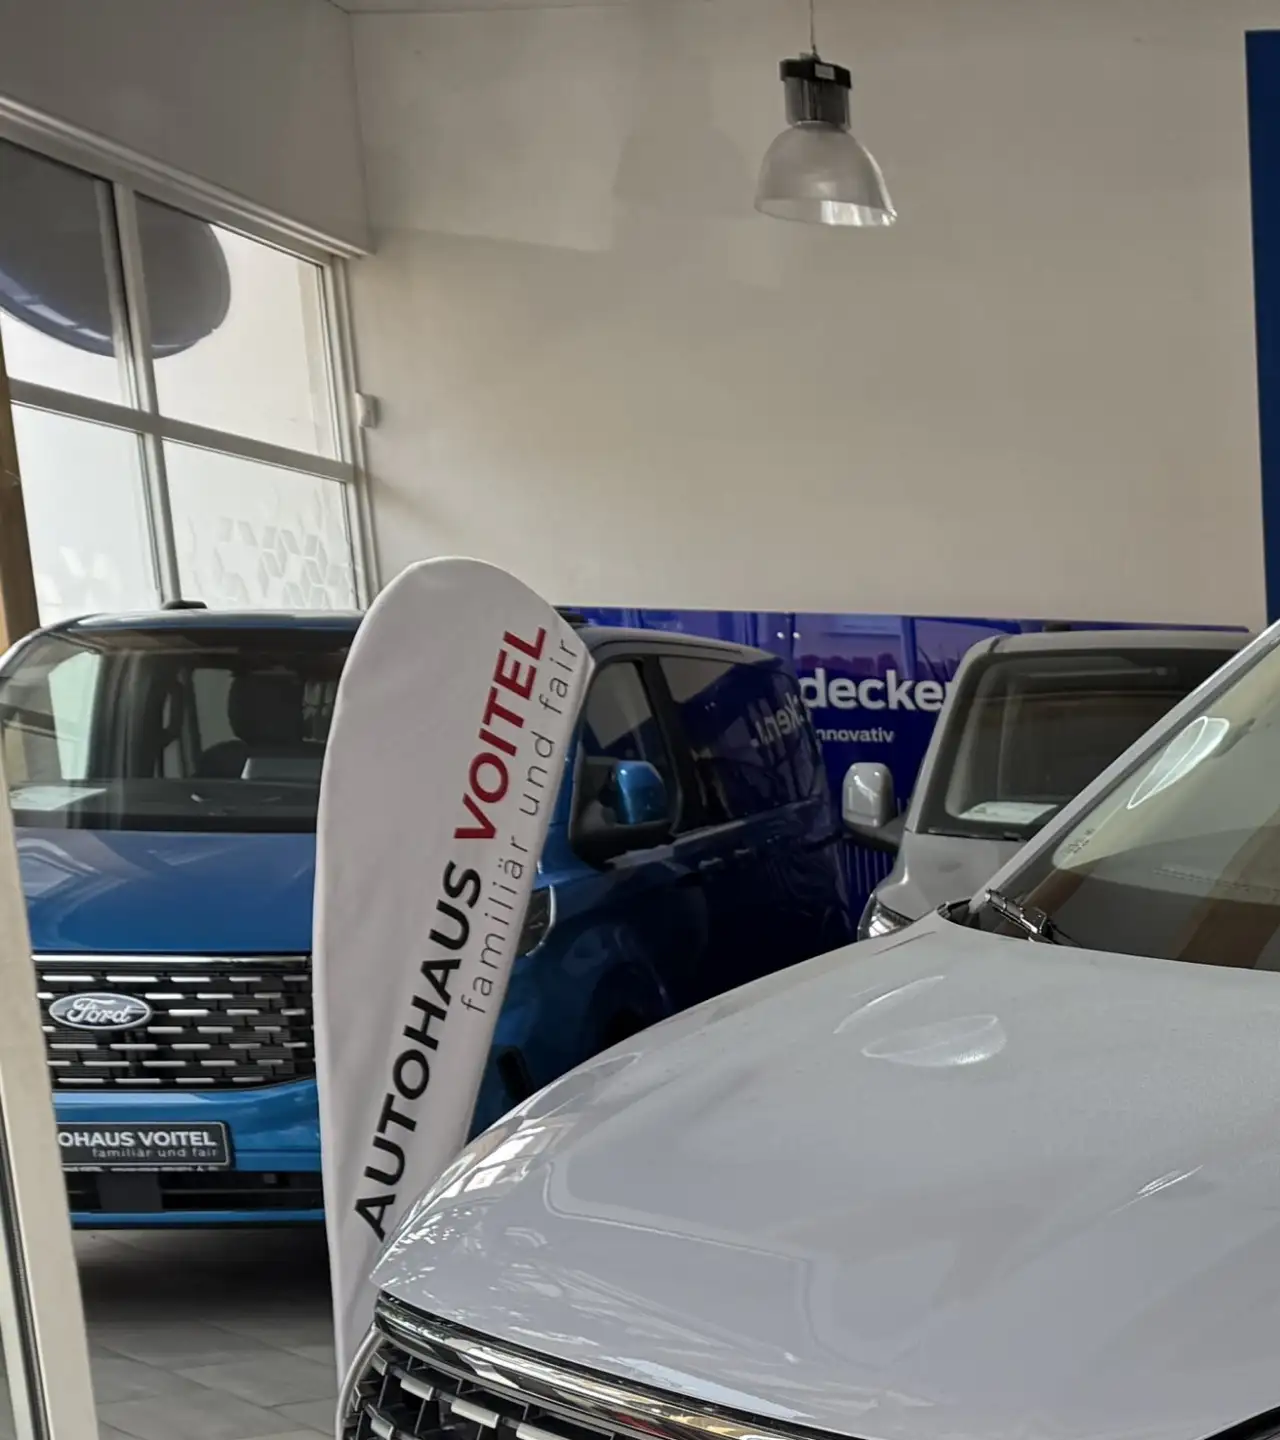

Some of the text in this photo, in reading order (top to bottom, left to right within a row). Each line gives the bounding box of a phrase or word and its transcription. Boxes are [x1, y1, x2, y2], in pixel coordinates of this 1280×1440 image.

[460, 639, 578, 1014] familiär und fair
[355, 627, 547, 1243] AUTOHAUS VOITEL
[67, 997, 131, 1023] Ford
[138, 1131, 217, 1147] VOITEL
[158, 1148, 186, 1158] und
